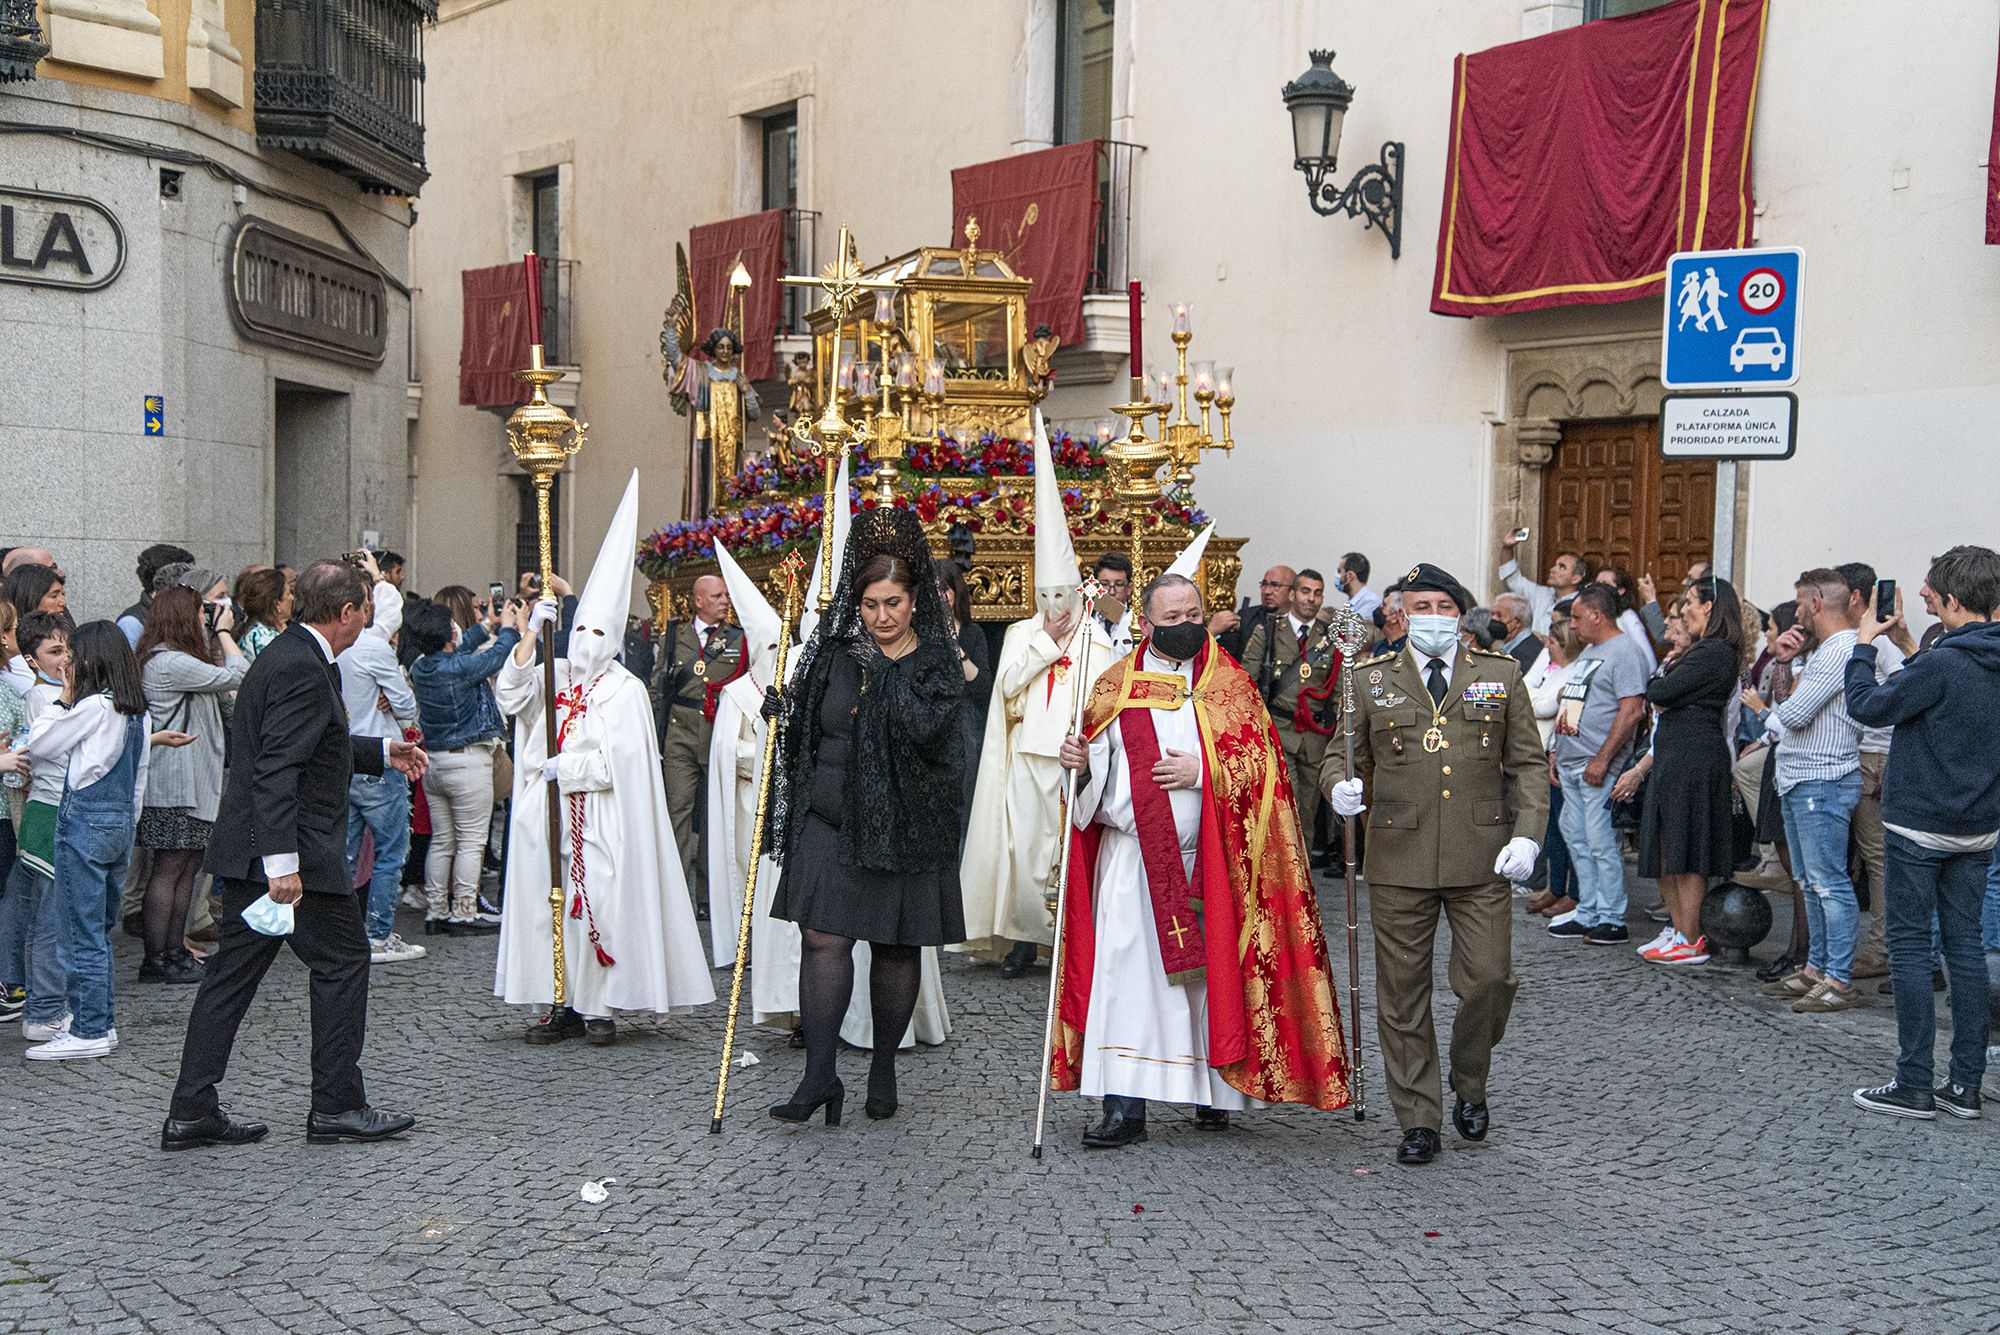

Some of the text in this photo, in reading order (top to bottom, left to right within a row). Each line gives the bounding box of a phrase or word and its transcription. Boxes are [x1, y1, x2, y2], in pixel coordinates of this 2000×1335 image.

[1, 204, 93, 275] LA
[244, 250, 316, 320] BUTANO
[1749, 283, 1775, 298] 20
[1703, 408, 1750, 417] CALZADA
[1676, 421, 1777, 431] PLATAFORMA ÚNICA
[1669, 435, 1781, 444] PRIORIDAD PEATONAL
